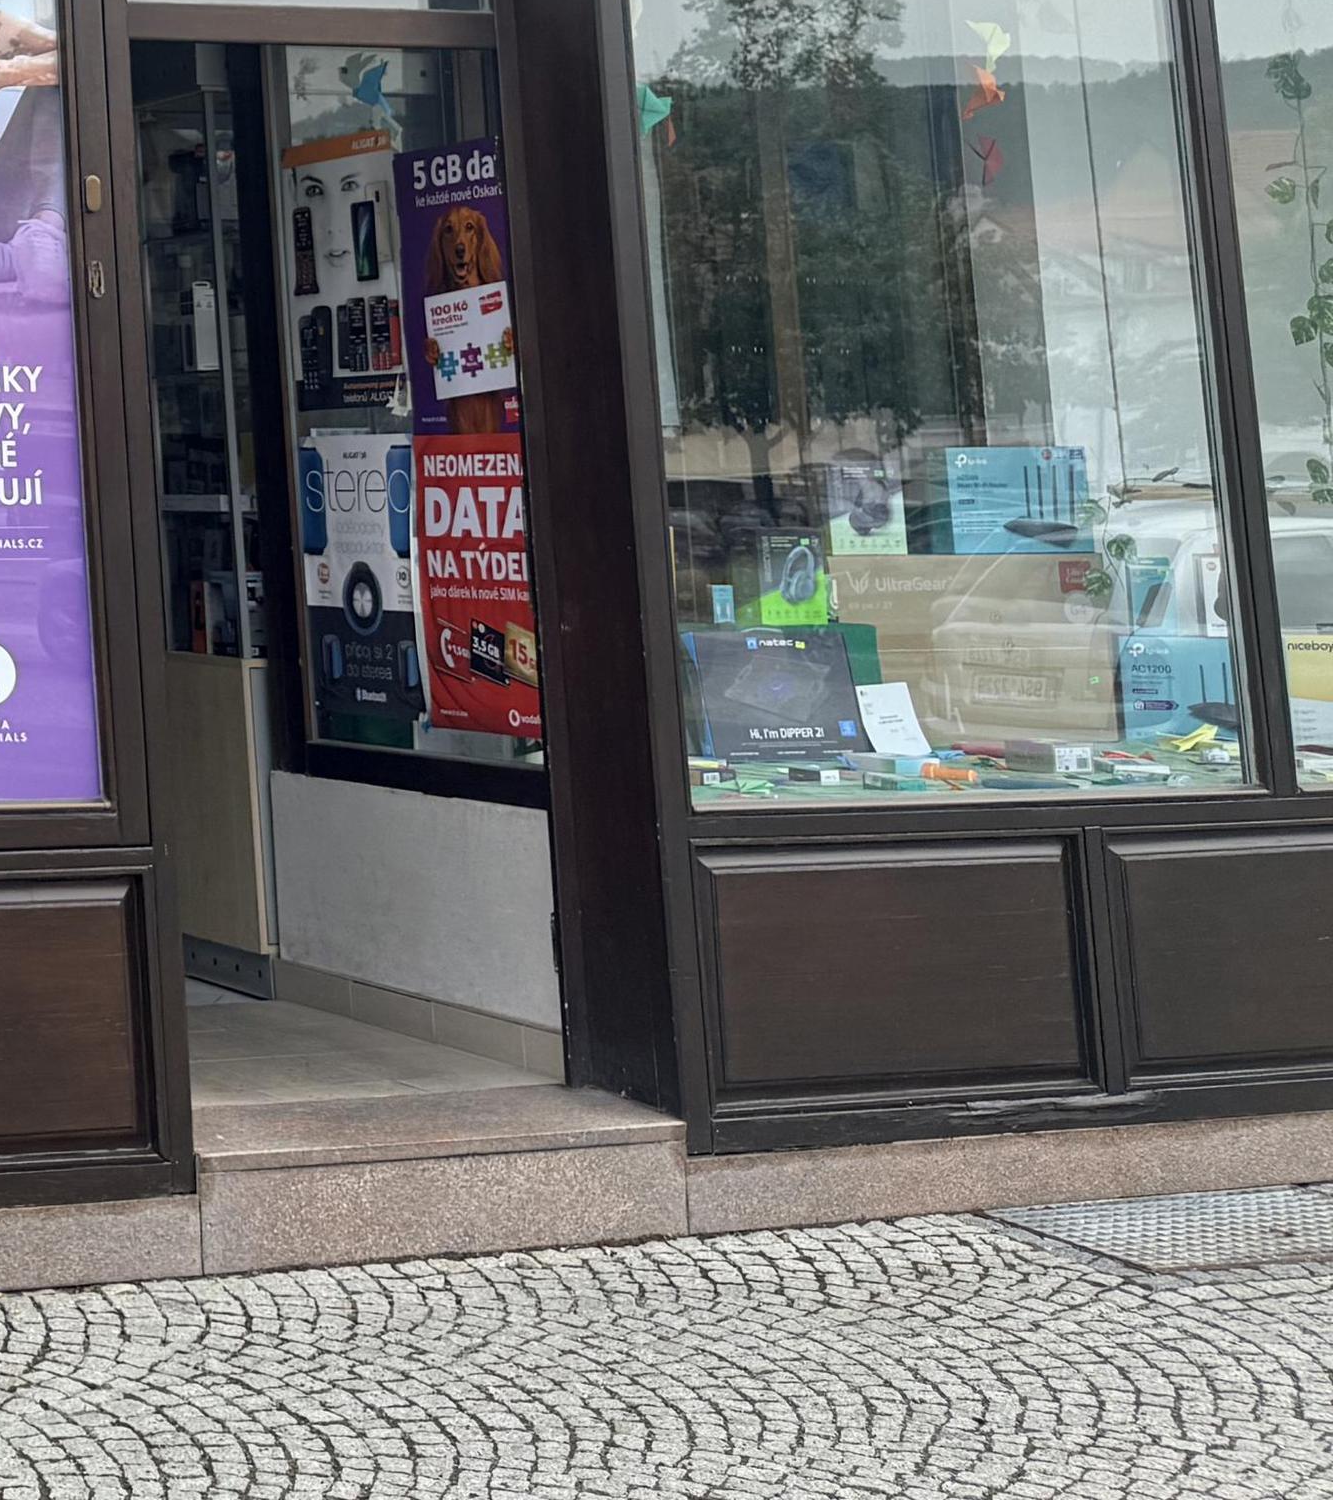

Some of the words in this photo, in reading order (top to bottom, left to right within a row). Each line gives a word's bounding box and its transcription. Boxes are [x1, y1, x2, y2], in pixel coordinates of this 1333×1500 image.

[413, 160, 426, 189] 5
[431, 154, 462, 186] GB
[466, 150, 496, 181] da
[451, 189, 471, 203] nové
[430, 304, 451, 316] 100
[423, 454, 523, 476] NEOMEZEN
[306, 459, 410, 513] stereo
[424, 487, 524, 538] DATA
[427, 550, 460, 578] NA
[875, 573, 948, 591] UltraGear
[759, 638, 793, 647] natec
[780, 729, 813, 738] DIPPER
